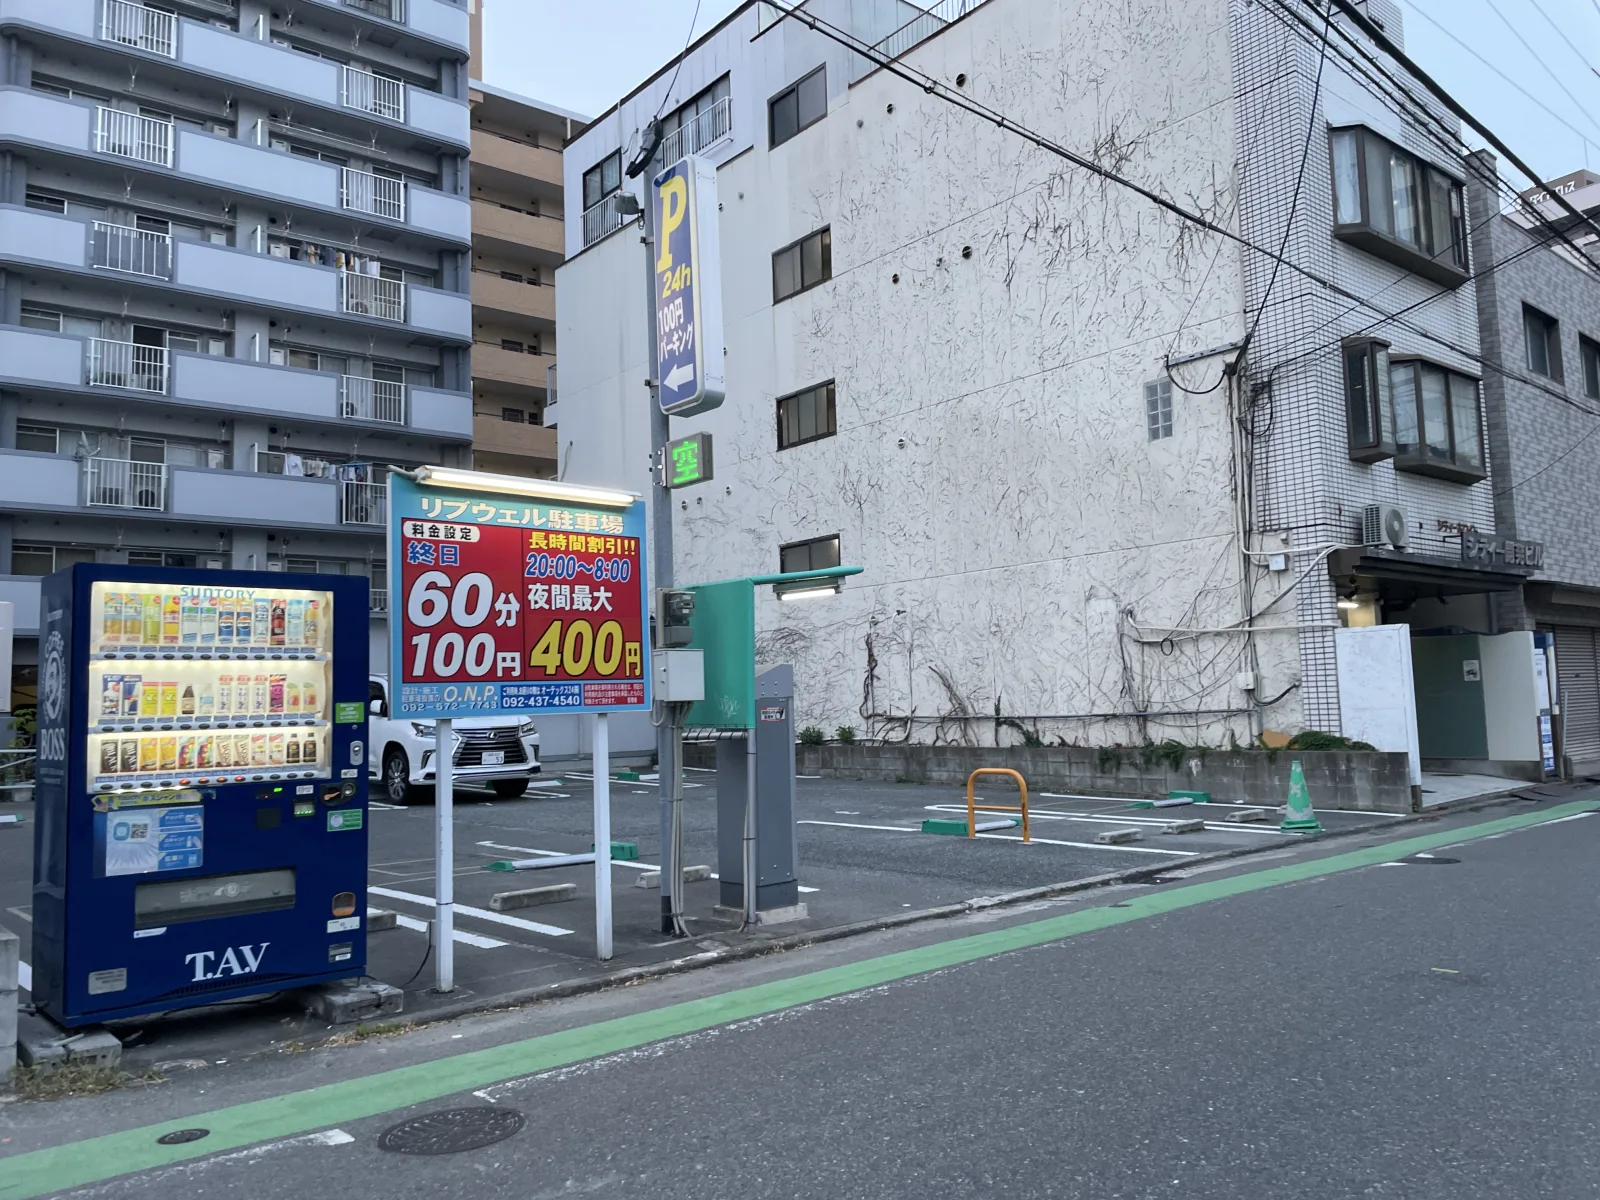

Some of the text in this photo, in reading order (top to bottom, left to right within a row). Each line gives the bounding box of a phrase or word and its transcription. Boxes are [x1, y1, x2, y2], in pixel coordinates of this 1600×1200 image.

[657, 175, 687, 274] P
[662, 263, 691, 299] 24h
[658, 297, 684, 335] 100円
[660, 321, 693, 363] パーキング
[672, 440, 699, 484] 空
[411, 523, 472, 541] 料金設定
[529, 532, 635, 555] 長時間割引!!
[407, 541, 460, 566] 終日
[407, 570, 521, 628] 60分
[528, 583, 613, 612] 夜間最大
[410, 632, 521, 678] 100円
[529, 619, 641, 677] 400円
[443, 685, 498, 703] O.N.P.
[502, 695, 580, 708] 092-437-4540
[40, 728, 66, 760] BOSS
[185, 942, 270, 982] T.A.V
